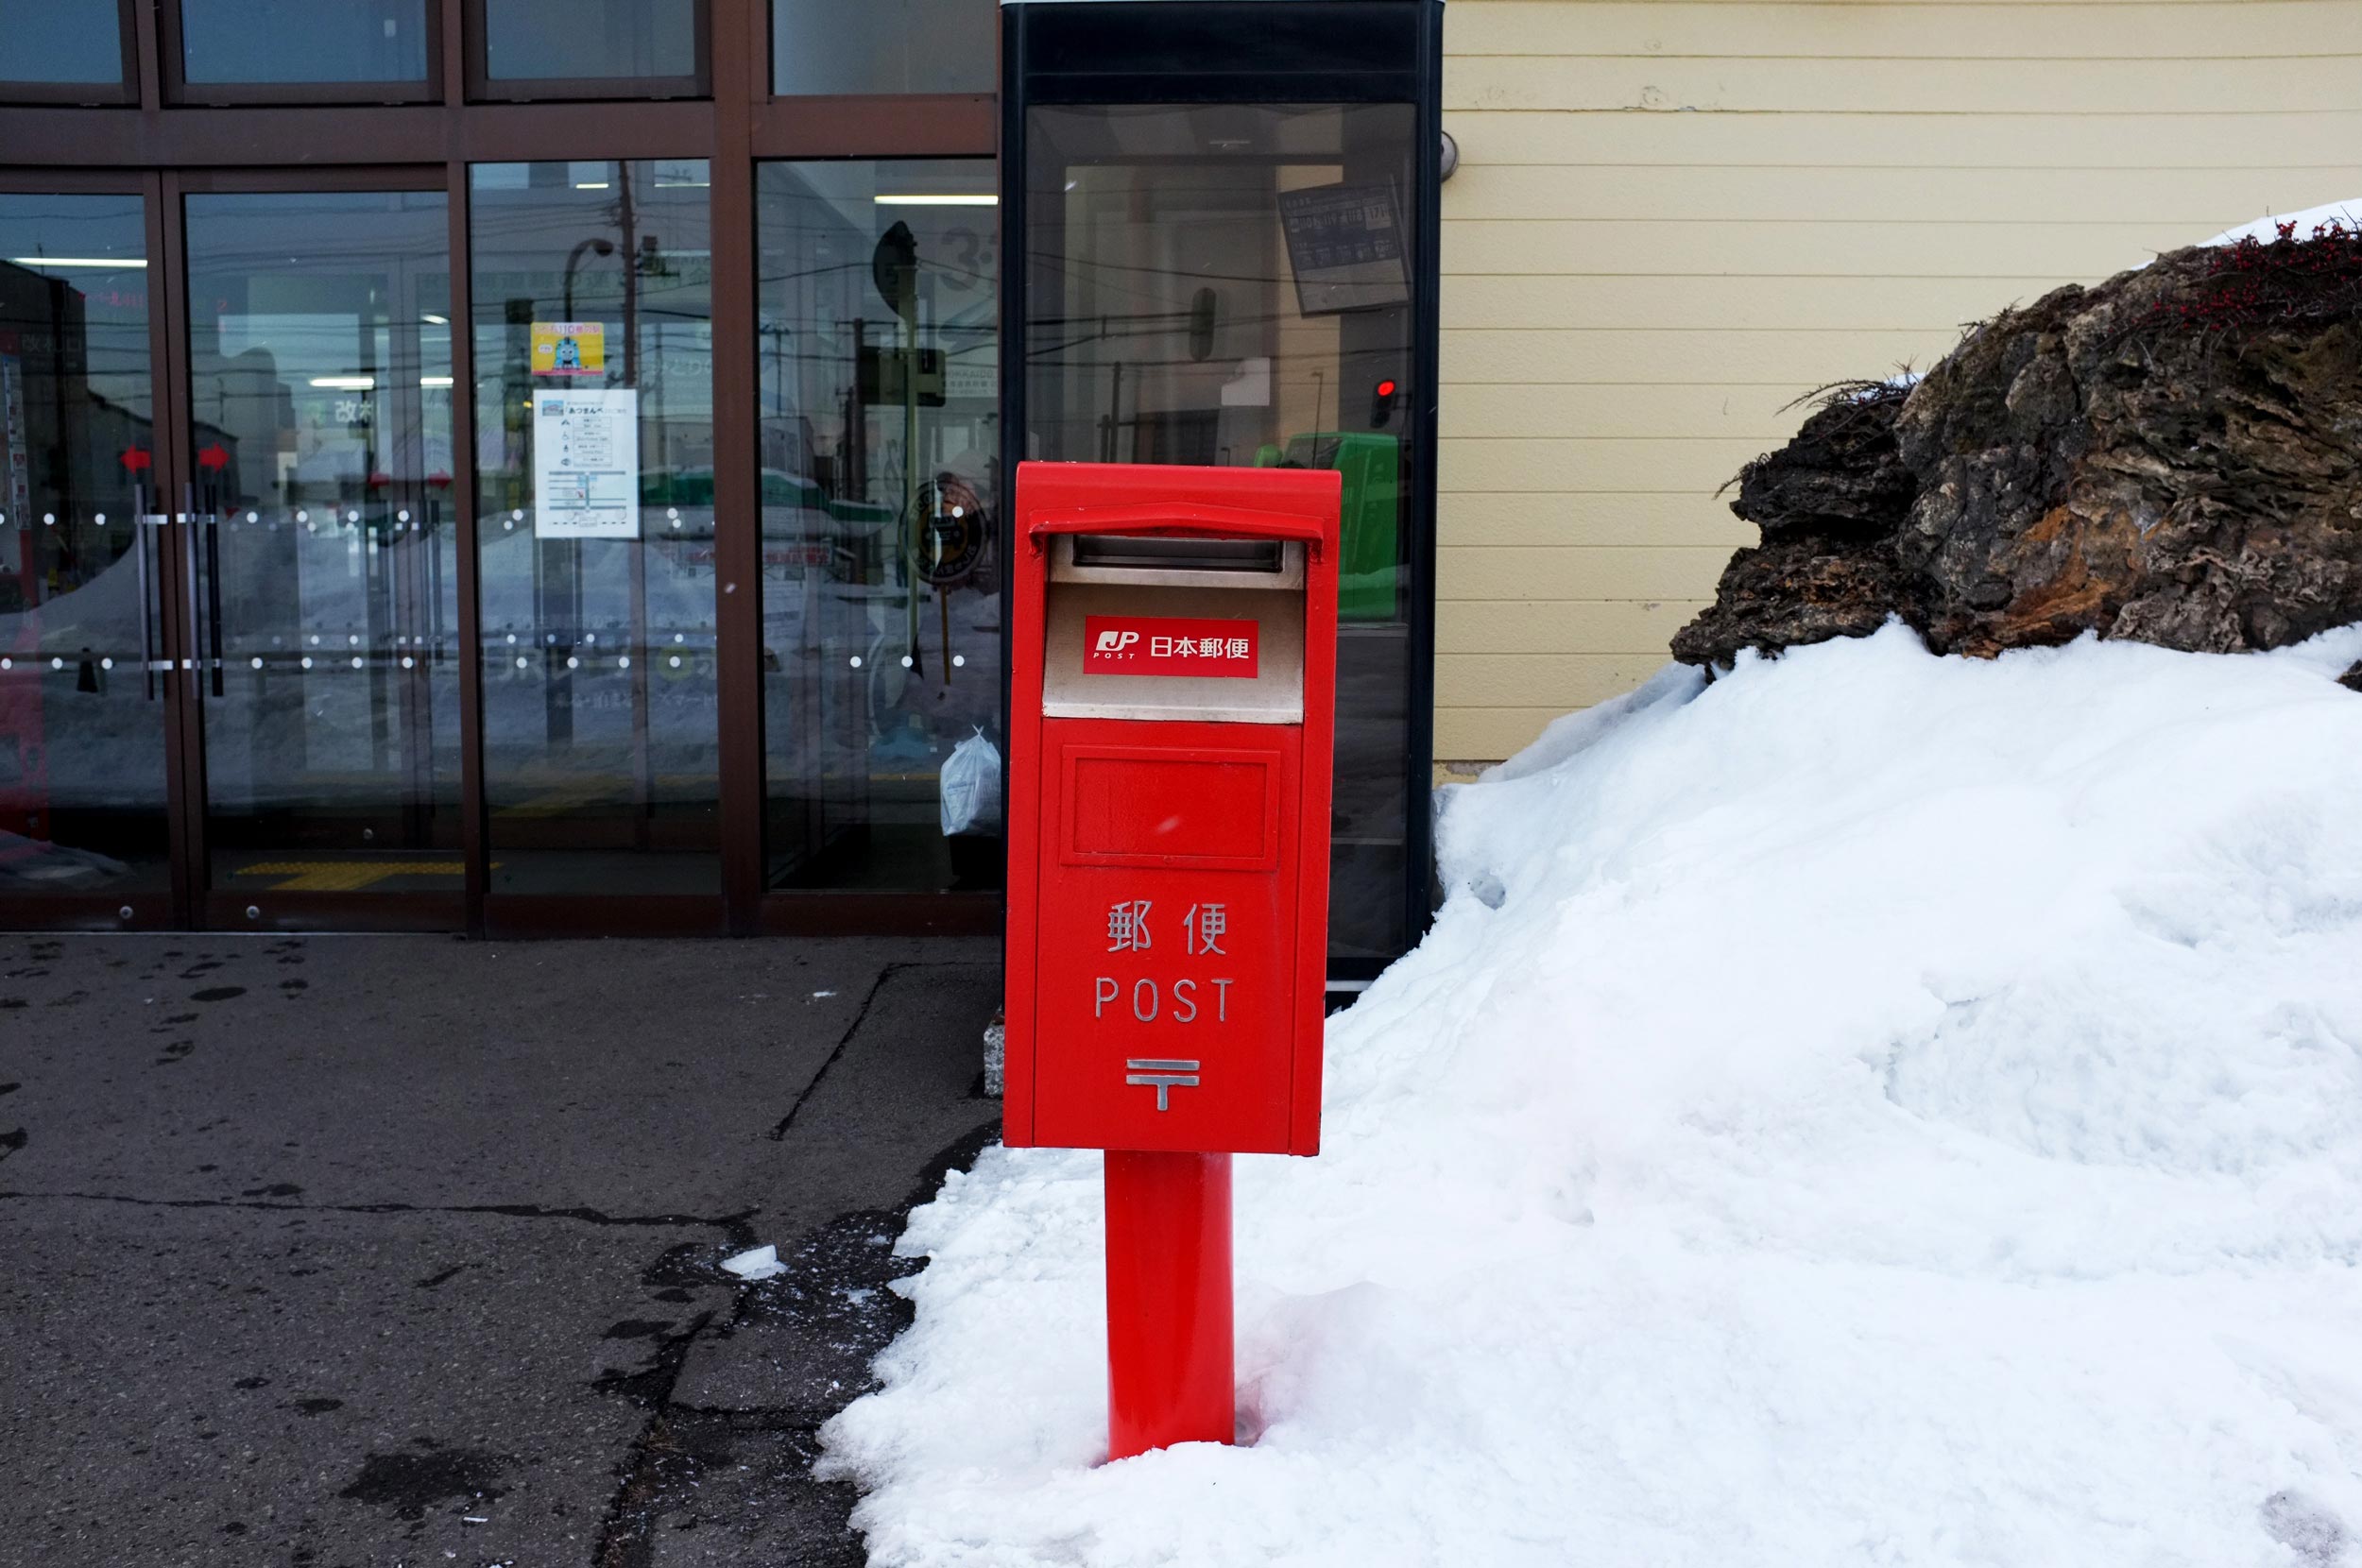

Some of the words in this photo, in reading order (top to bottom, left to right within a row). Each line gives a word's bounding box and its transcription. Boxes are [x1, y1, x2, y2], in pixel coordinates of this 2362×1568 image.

[1095, 630, 1139, 652] JP
[1151, 636, 1249, 659] 日本郵便
[1107, 901, 1226, 955] 郵便
[1095, 977, 1234, 1023] POST
